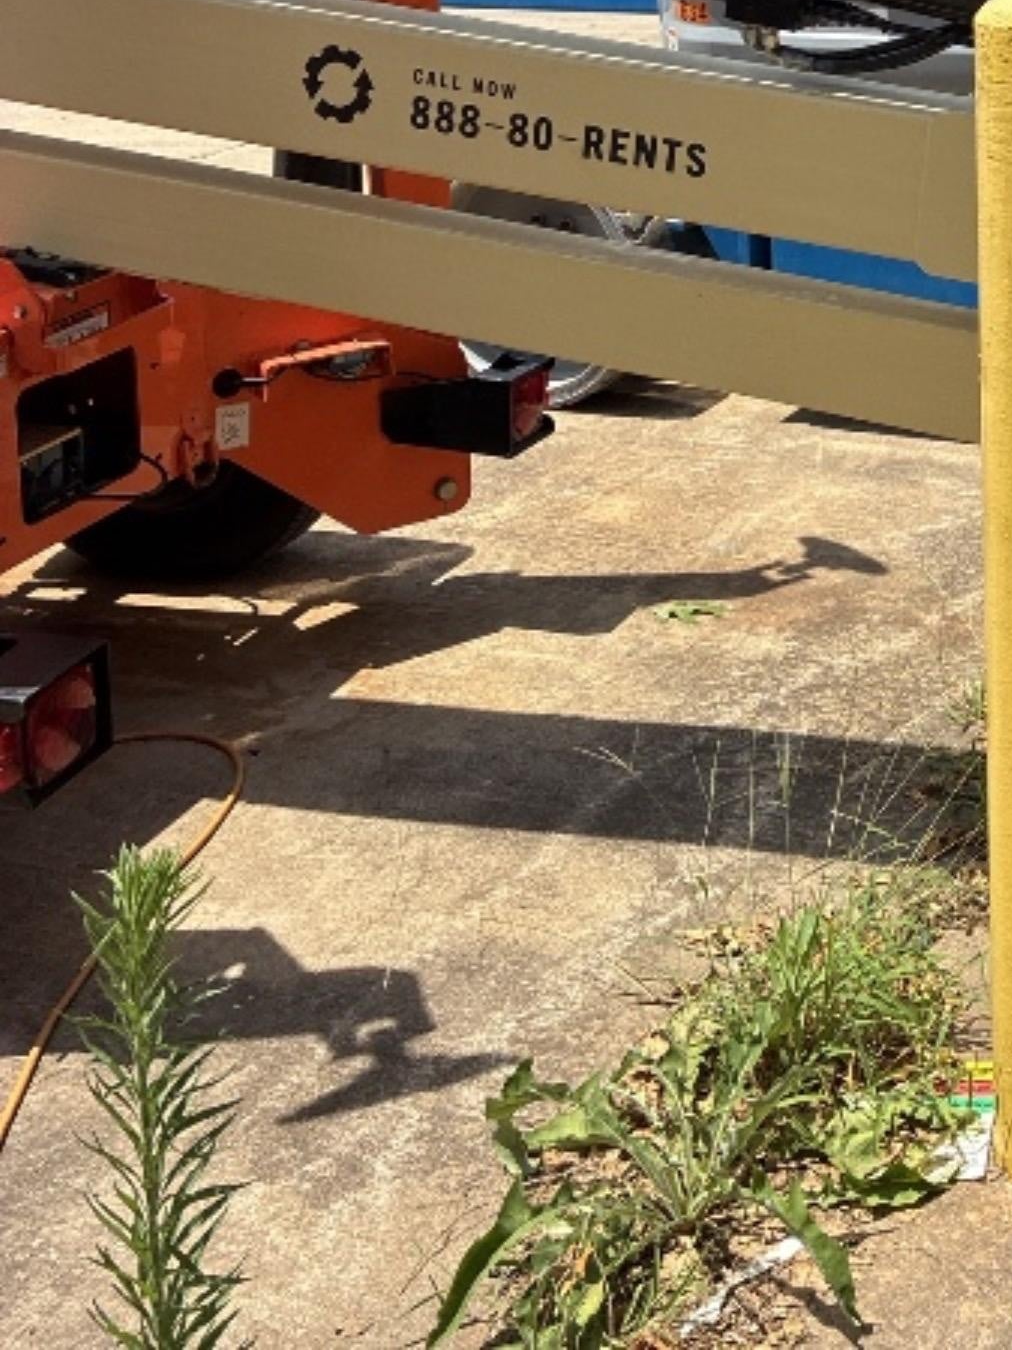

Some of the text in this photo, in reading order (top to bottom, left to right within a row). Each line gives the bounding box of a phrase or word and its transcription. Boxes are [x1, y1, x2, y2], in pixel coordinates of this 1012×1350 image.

[413, 68, 517, 100] CALL NOW
[410, 95, 707, 178] 888-80-RENTS
